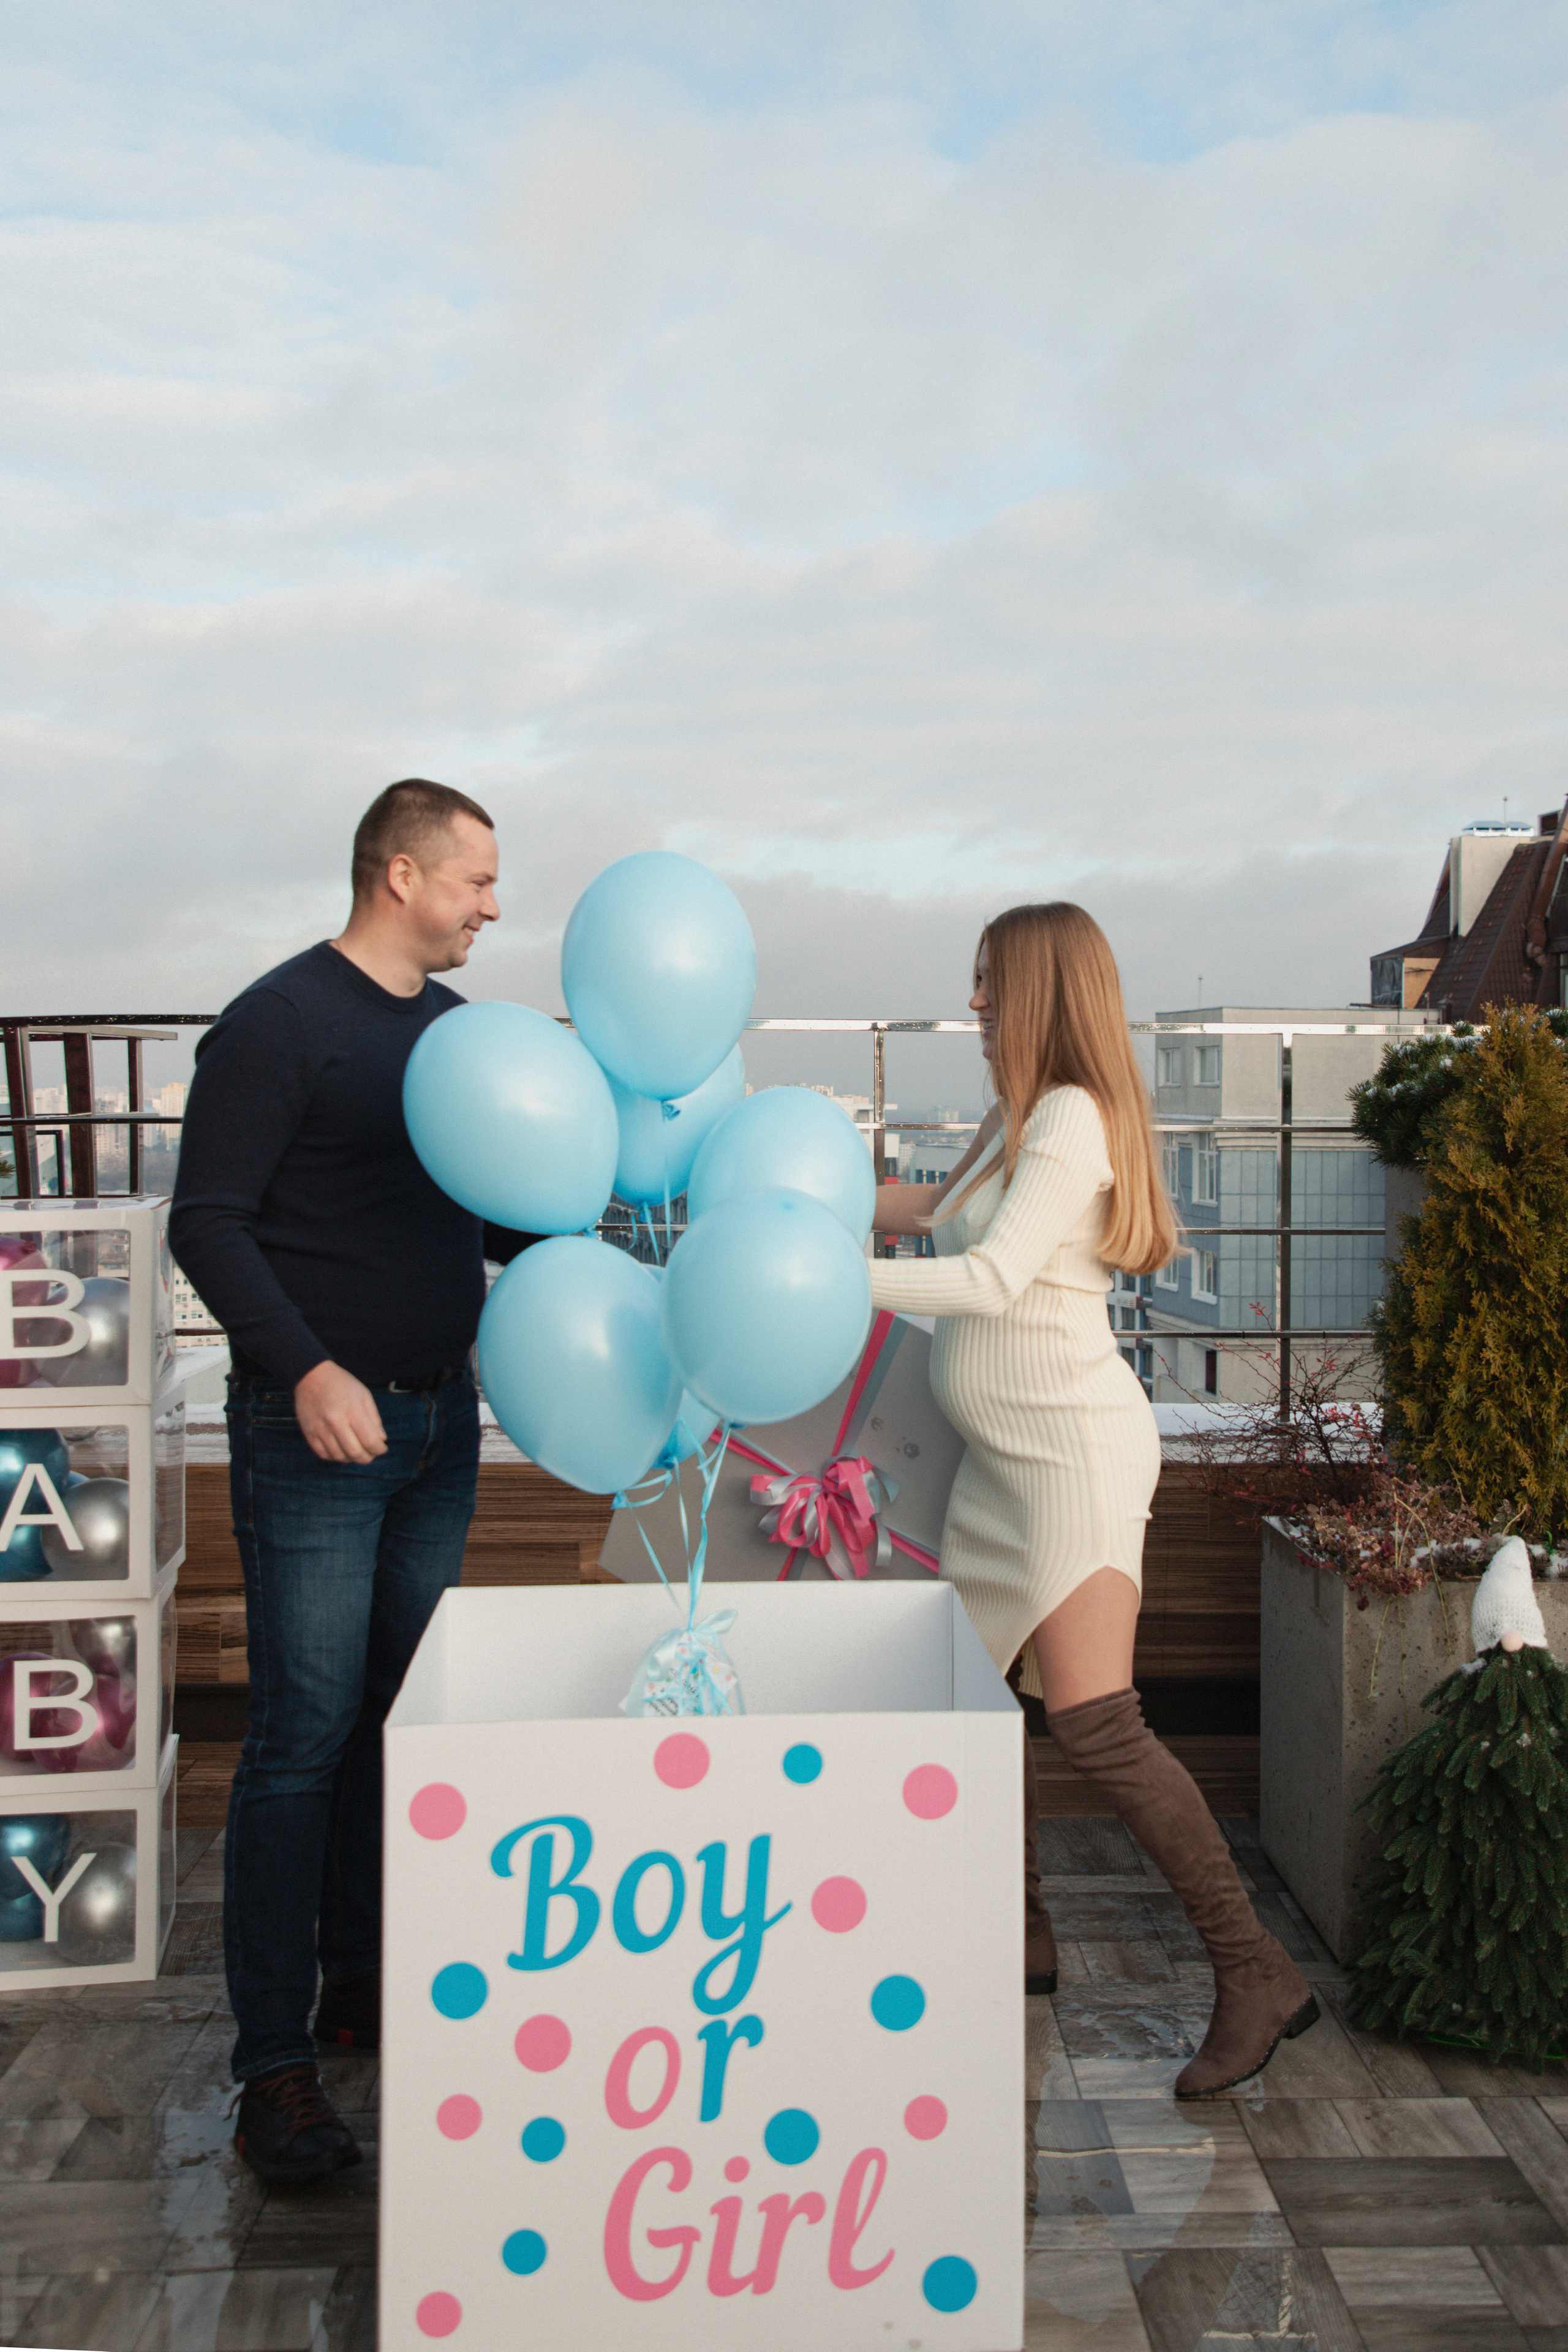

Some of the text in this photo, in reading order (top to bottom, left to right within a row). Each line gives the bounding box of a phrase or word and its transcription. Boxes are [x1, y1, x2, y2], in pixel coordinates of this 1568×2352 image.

[490, 1815, 793, 2016] Boy
[605, 2013, 765, 2130] or
[603, 2146, 895, 2302] Girl
